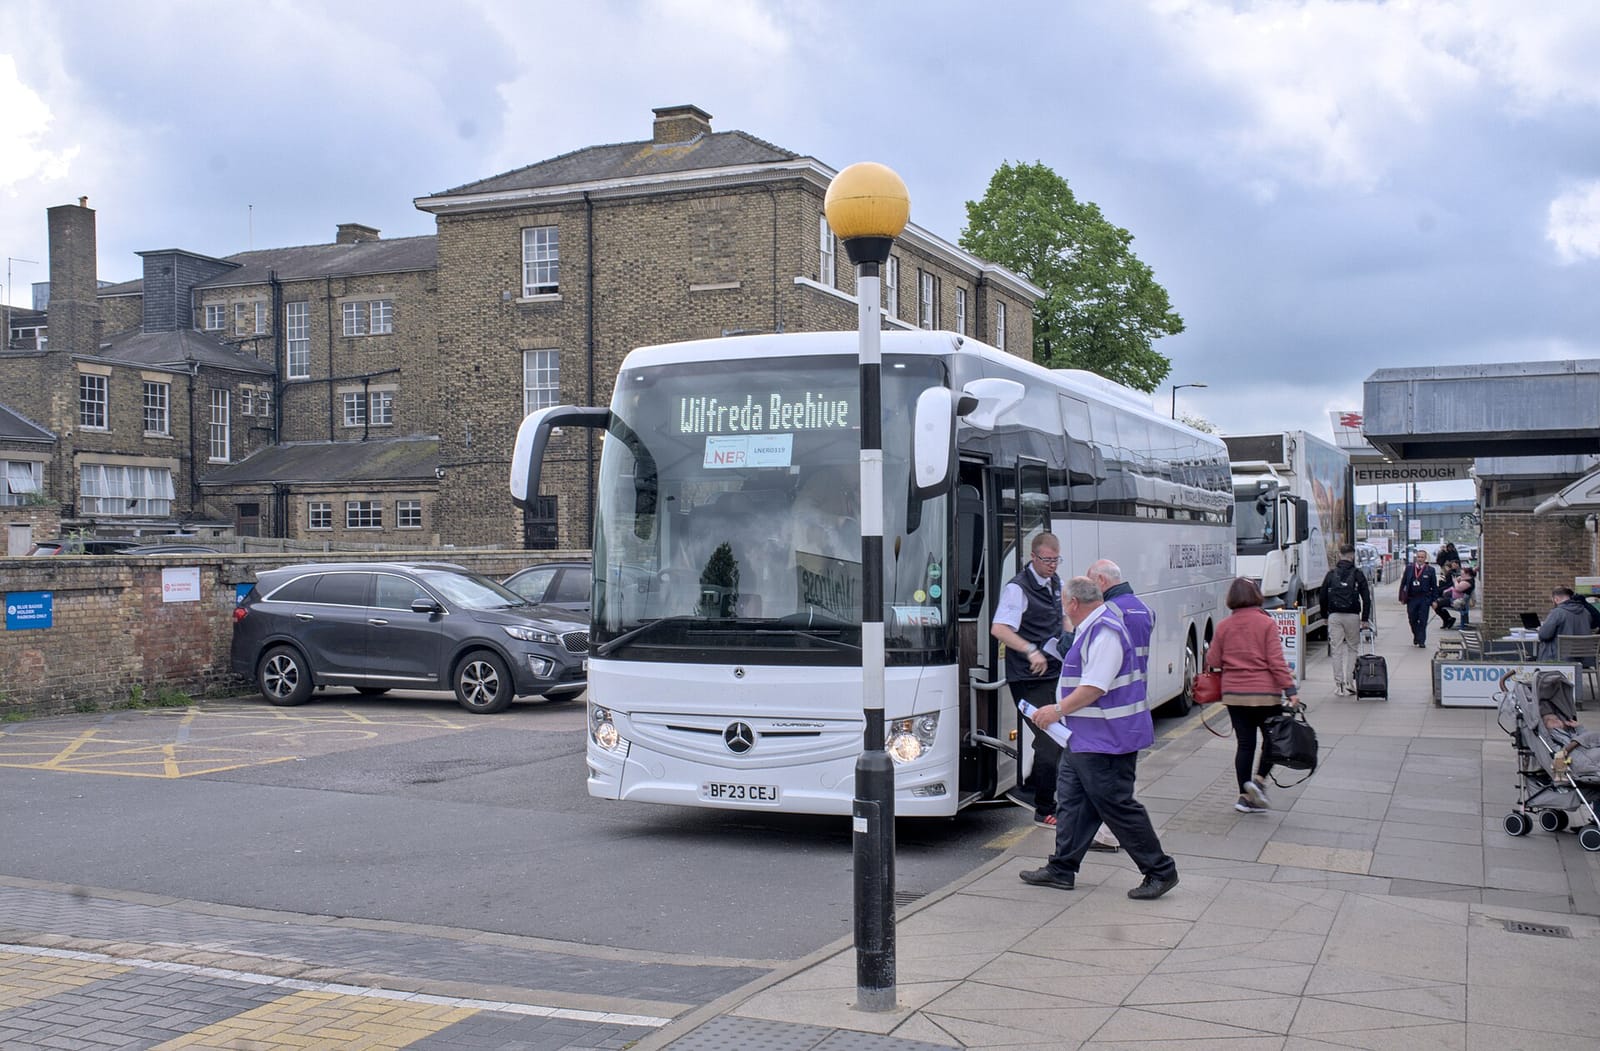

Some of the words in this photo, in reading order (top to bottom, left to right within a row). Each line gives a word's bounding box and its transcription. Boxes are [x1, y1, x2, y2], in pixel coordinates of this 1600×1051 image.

[680, 395, 762, 433] Wilfreda
[769, 392, 848, 430] Beehive
[705, 450, 745, 464] LNER
[1355, 468, 1456, 480] ETERBOROUGH
[710, 784, 745, 798] BF23
[749, 786, 776, 800] CEJ
